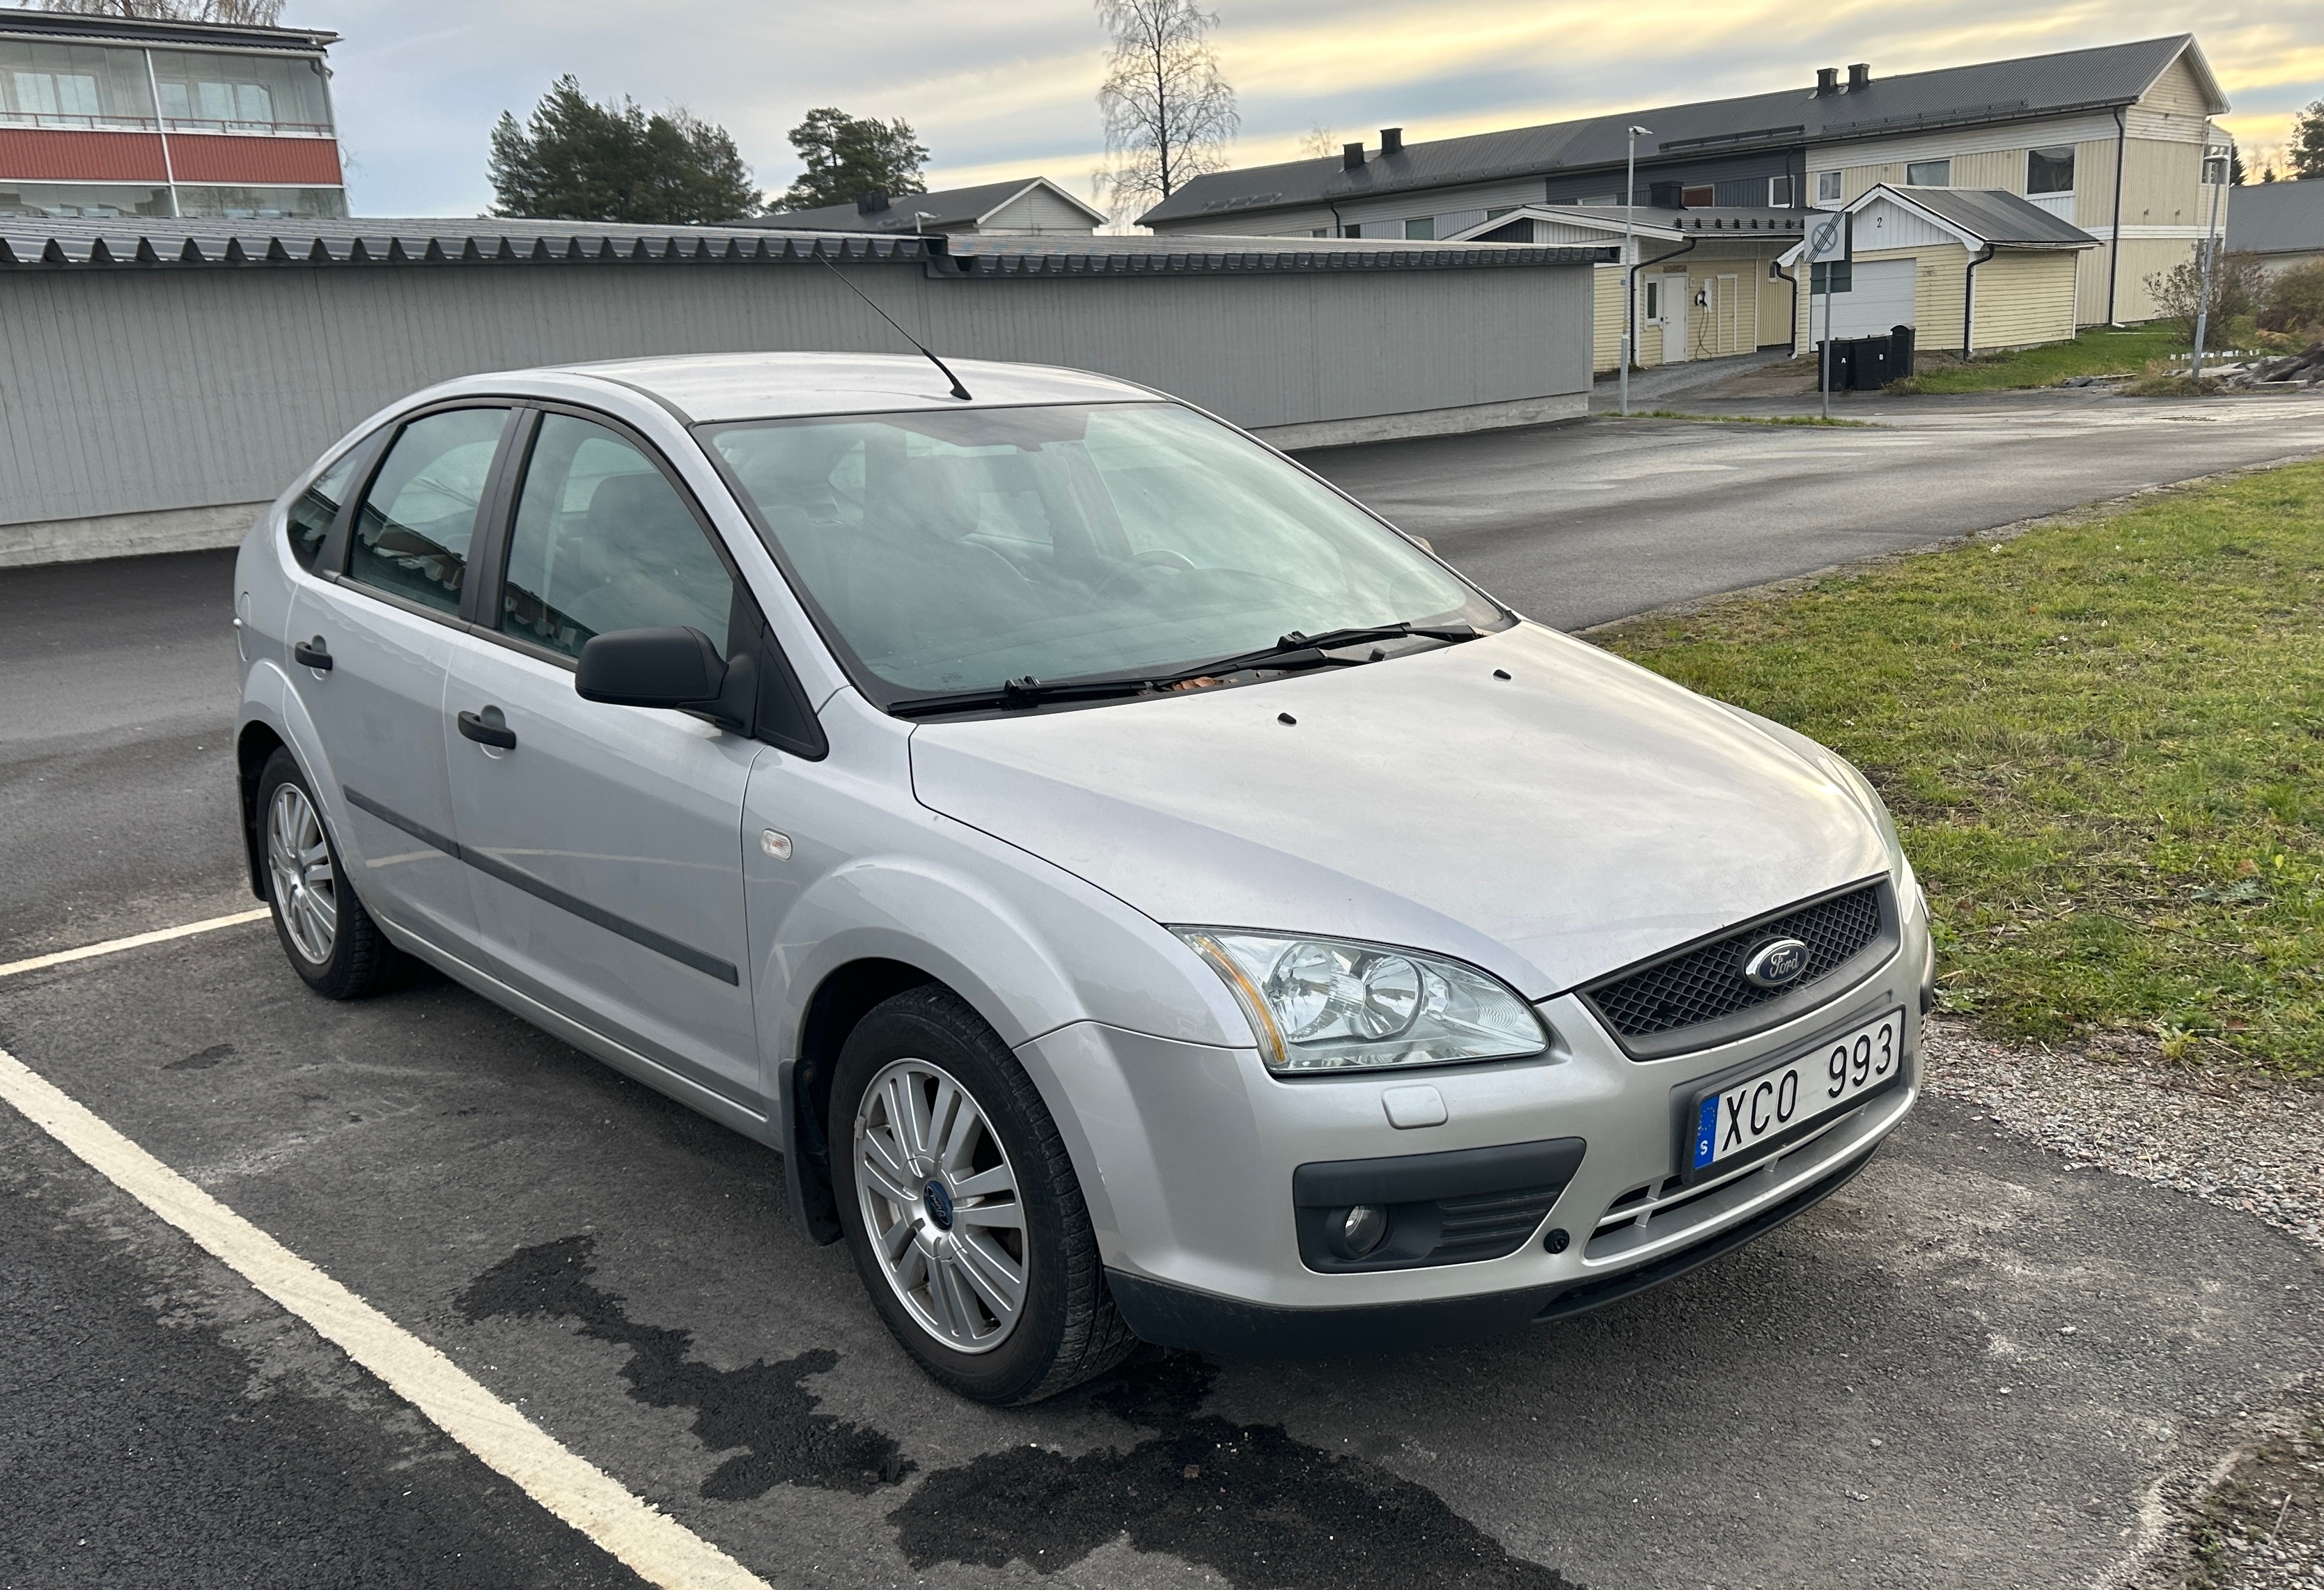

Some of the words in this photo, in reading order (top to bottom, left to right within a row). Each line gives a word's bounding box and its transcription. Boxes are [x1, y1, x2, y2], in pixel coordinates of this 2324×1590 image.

[1877, 217, 1882, 228] 2
[1770, 949, 1800, 978] Ford
[1700, 1139, 1708, 1155] S
[1722, 1069, 1798, 1151] XCO
[1827, 1023, 1892, 1098] 993
[929, 1192, 946, 1217] Ford
